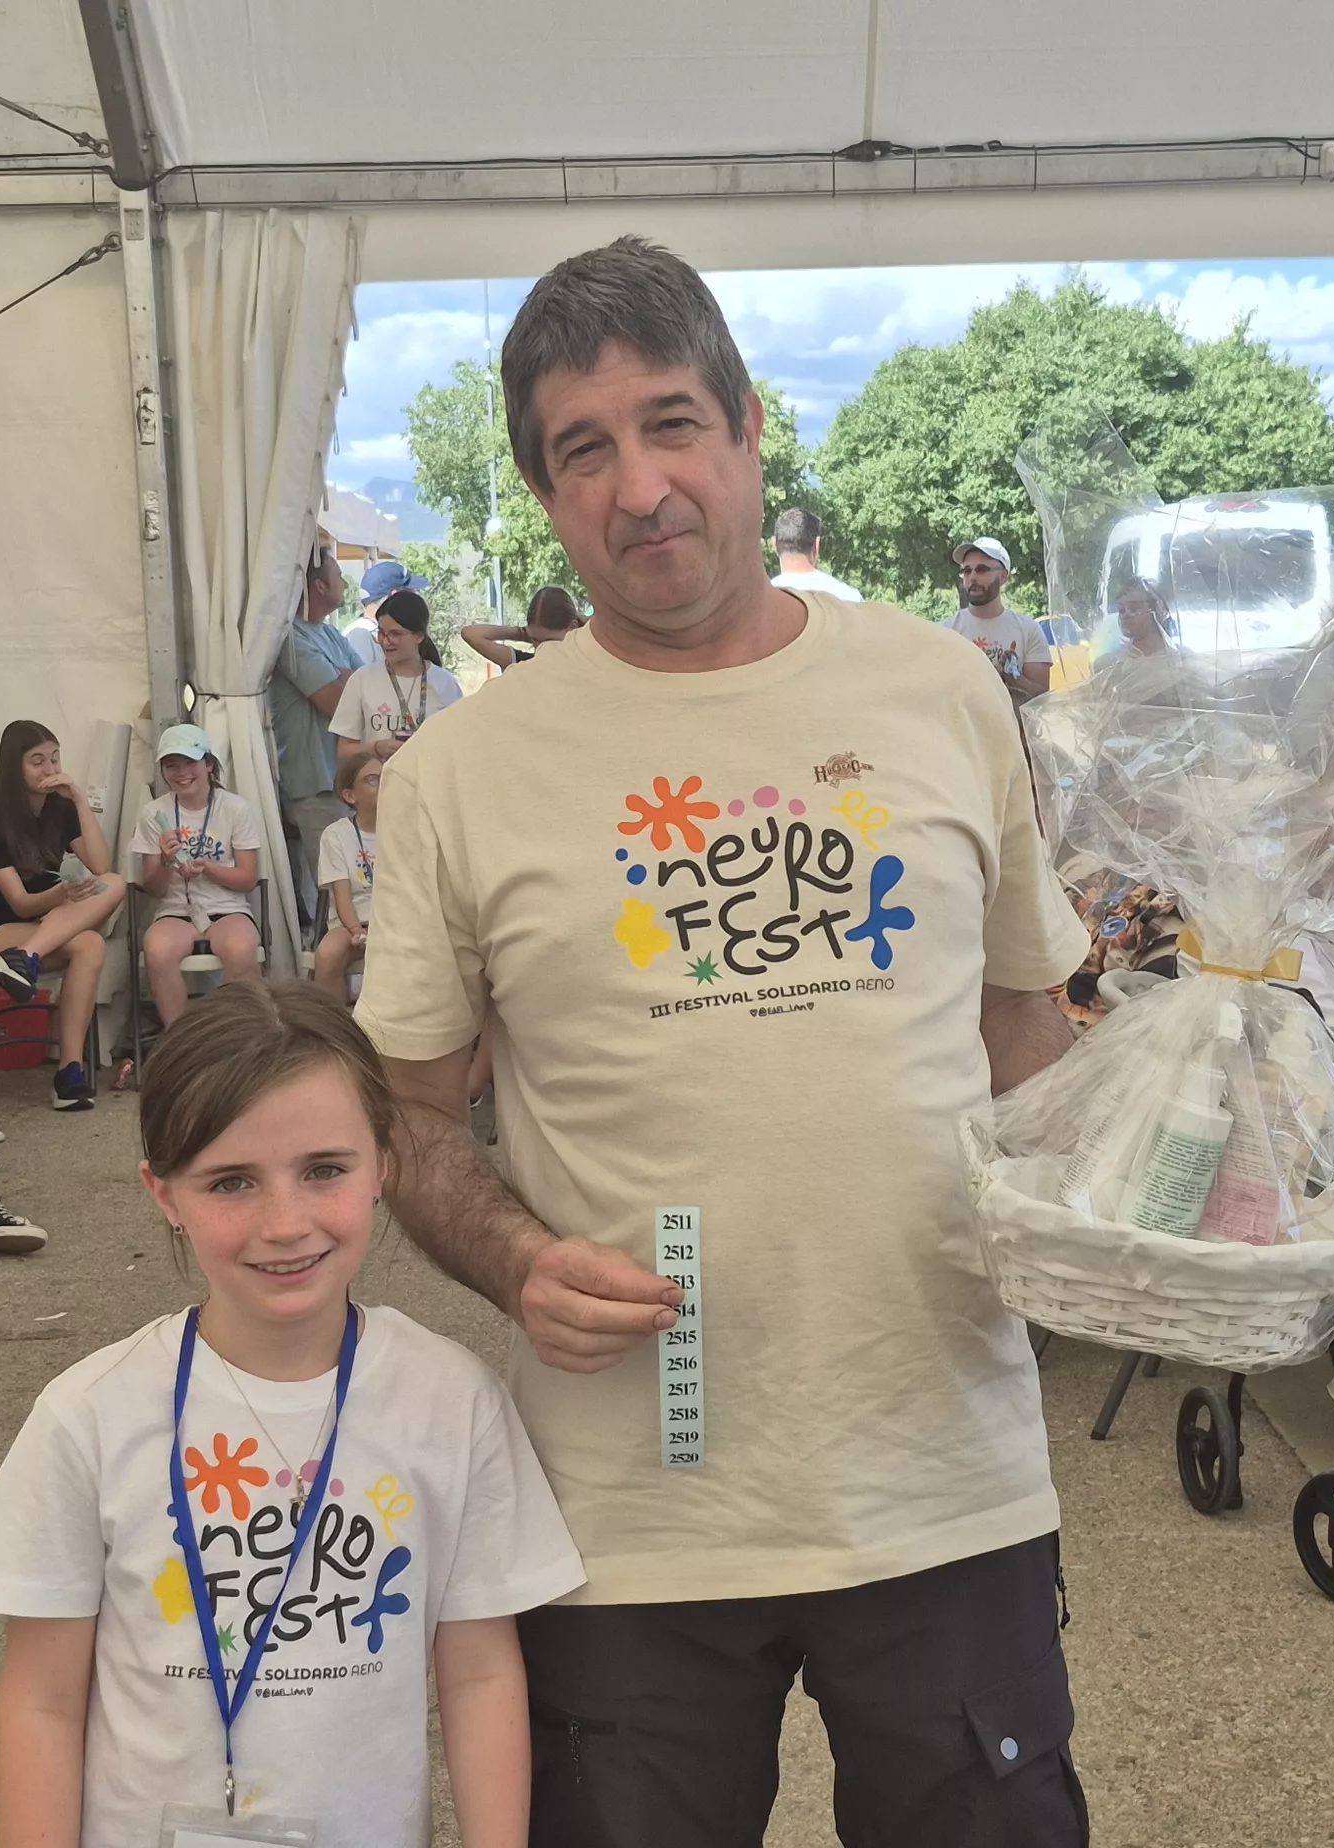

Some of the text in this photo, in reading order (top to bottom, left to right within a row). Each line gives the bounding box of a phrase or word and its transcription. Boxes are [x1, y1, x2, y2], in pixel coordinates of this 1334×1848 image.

[649, 1005, 672, 1018] III
[675, 991, 754, 1013] FESTIVAL
[757, 980, 851, 1000] SOLIDARIO
[855, 978, 895, 991] AENO
[662, 1214, 692, 1230] 2511
[663, 1245, 694, 1260] 2512
[671, 1304, 696, 1318] 514
[666, 1330, 697, 1345] 2515
[667, 1357, 697, 1371] 2516
[667, 1382, 698, 1396] 2517
[668, 1407, 698, 1421] 2518
[668, 1431, 699, 1444] 2519
[669, 1453, 699, 1464] 2520
[164, 1661, 383, 1681] III FESIVL SOLIDARIO AENO
